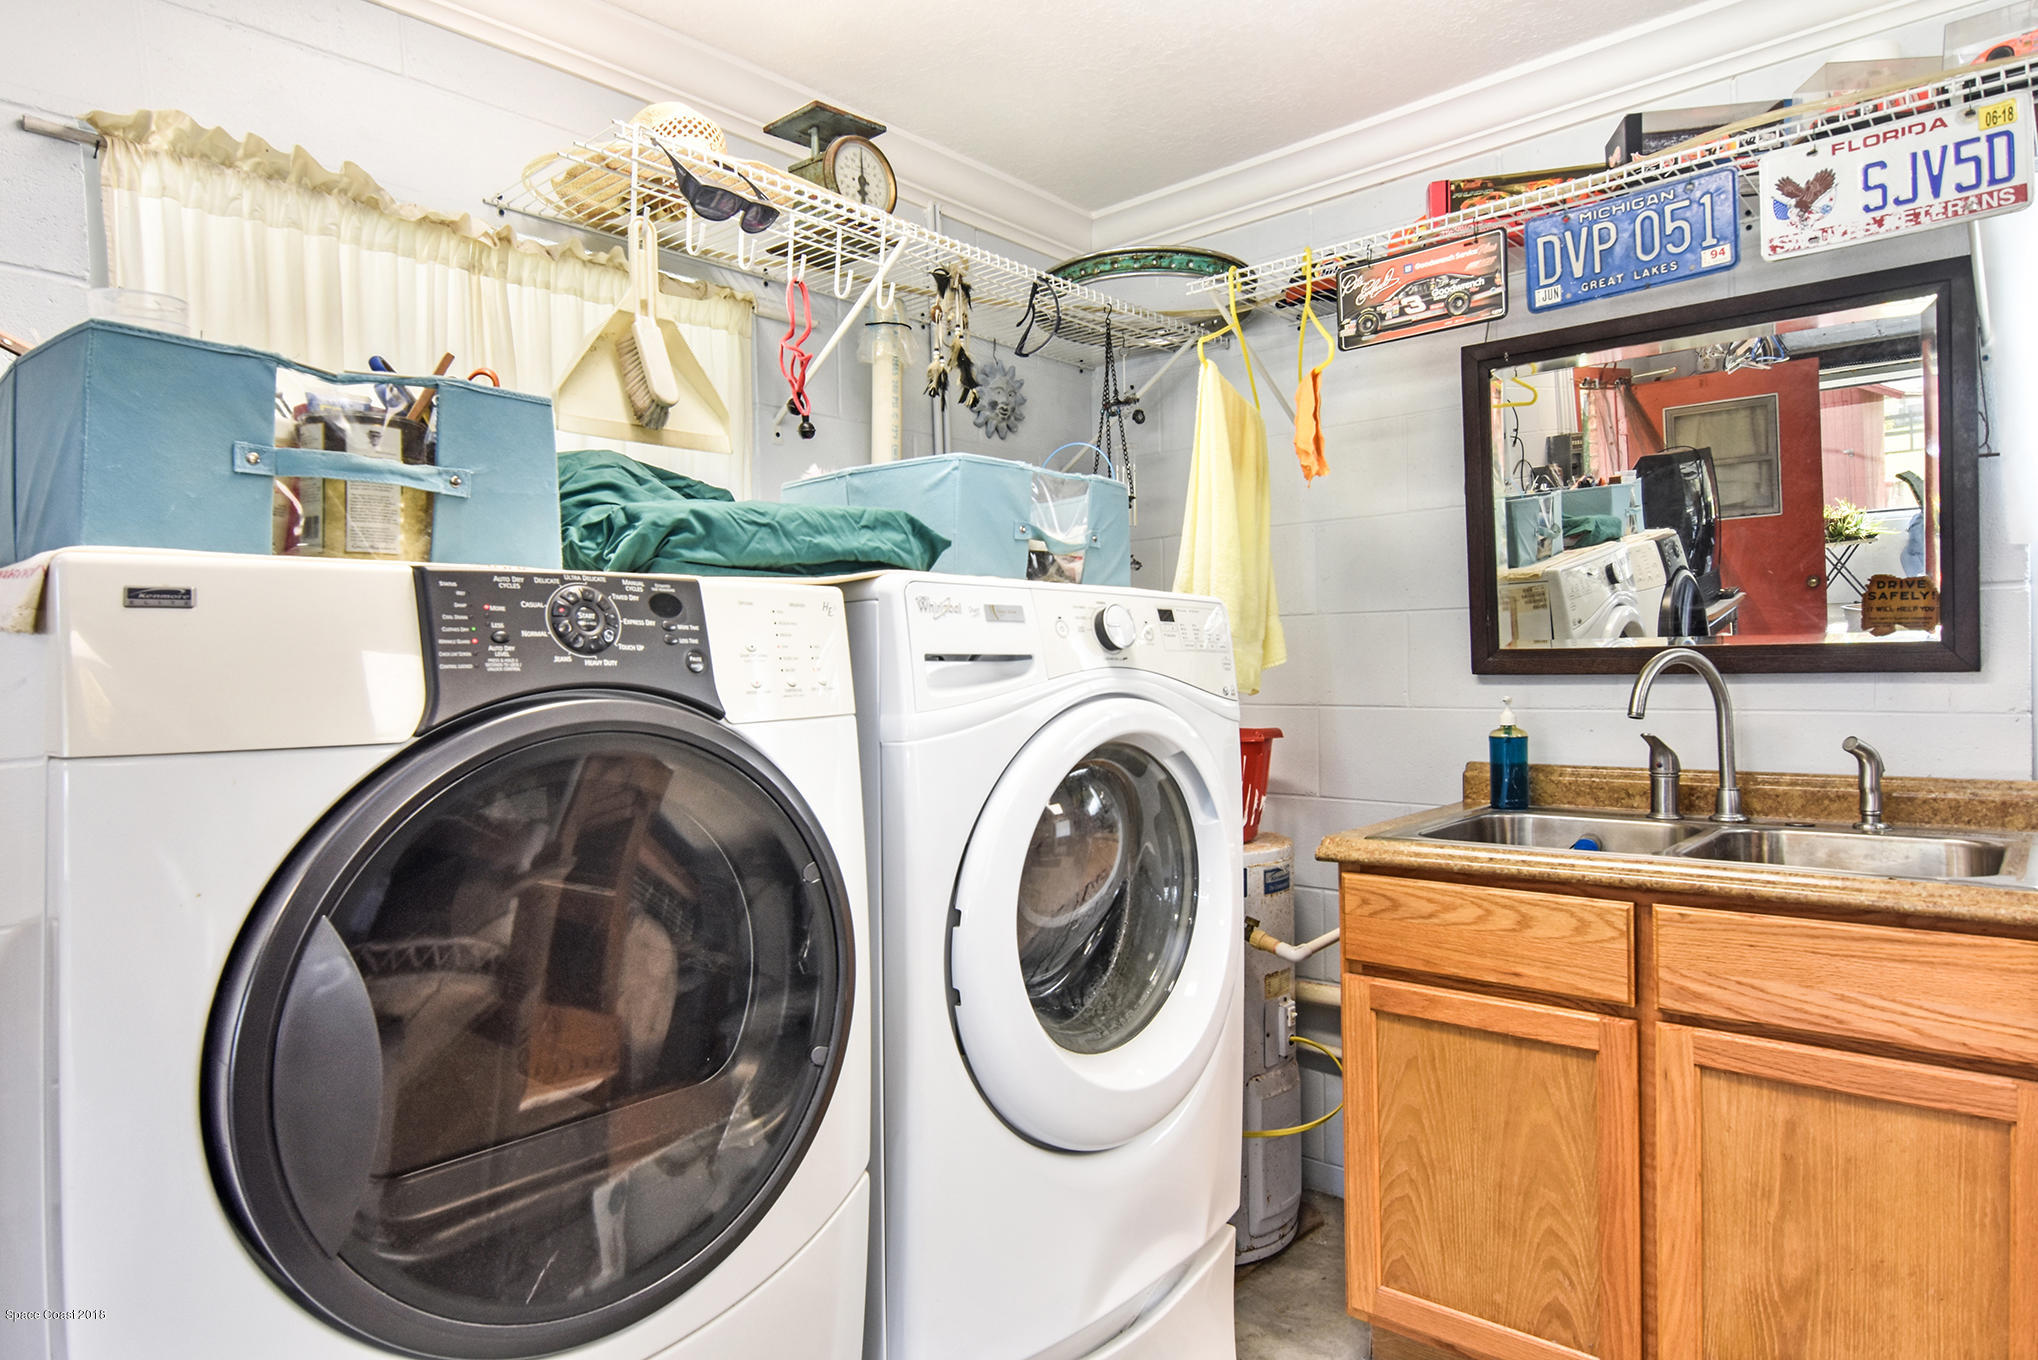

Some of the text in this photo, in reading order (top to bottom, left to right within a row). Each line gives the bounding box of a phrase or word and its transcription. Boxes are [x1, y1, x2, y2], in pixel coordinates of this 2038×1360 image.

[1985, 106, 2014, 127] 06-18
[1832, 117, 1948, 156] FLORIDA
[1862, 130, 2016, 213] SJV5D
[1579, 189, 1675, 223] MICHIGAN
[1885, 187, 2016, 231] ETERANS
[1536, 220, 1618, 286] DVP
[1634, 192, 1719, 261] 051
[1710, 247, 1726, 259] 94
[1581, 261, 1679, 292] GREAT LAKES
[1431, 277, 1486, 298] Goodwrench
[1542, 286, 1560, 302] JUN
[1401, 295, 1427, 316] 3
[533, 576, 561, 584] DELICATE
[582, 574, 607, 583] DELICATE
[1876, 579, 1927, 589] DRIVE
[1868, 591, 1937, 600] SAFELY!
[520, 600, 545, 608] CASUAL
[577, 611, 596, 619] START
[623, 618, 645, 626] EXPRESS
[618, 643, 636, 651] TOUCH
[553, 655, 573, 663] JEANS
[603, 659, 618, 667] DUTY
